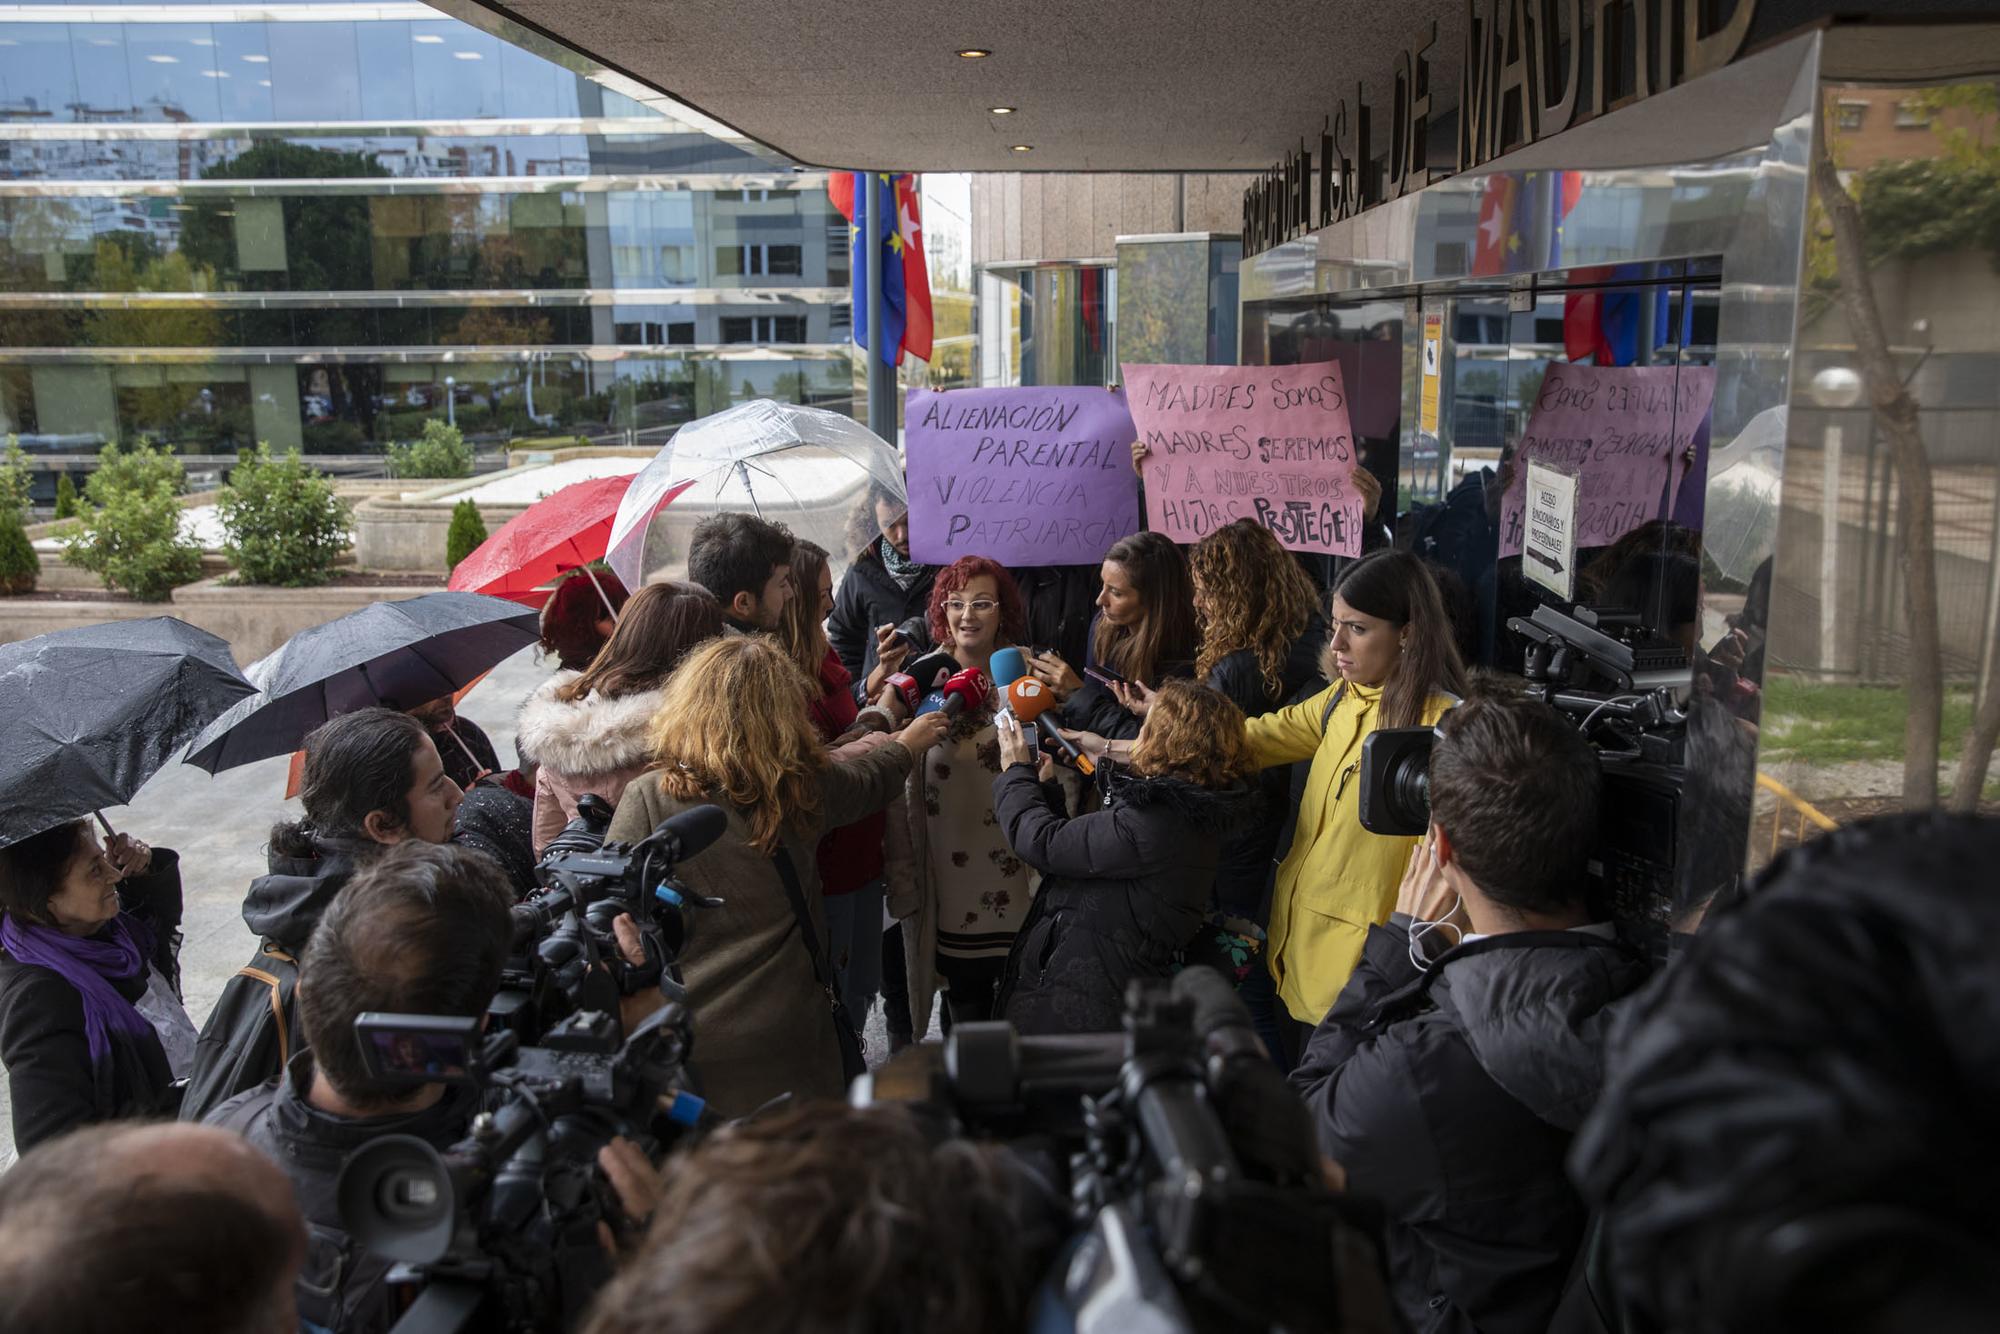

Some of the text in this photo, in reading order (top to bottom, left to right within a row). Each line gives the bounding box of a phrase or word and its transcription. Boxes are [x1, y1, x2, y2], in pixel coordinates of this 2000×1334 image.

[1389, 20, 1437, 199] DE
[1456, 0, 1756, 174] MAD
[922, 397, 1079, 432] ALIENACIÓN
[1146, 382, 1256, 412] MADRES
[972, 437, 1117, 469] PARENTAL
[1146, 425, 1349, 463] MADRES SEREMOS
[934, 475, 1088, 507] VIOLENCIA
[1155, 464, 1344, 500] Y A NUESTROS
